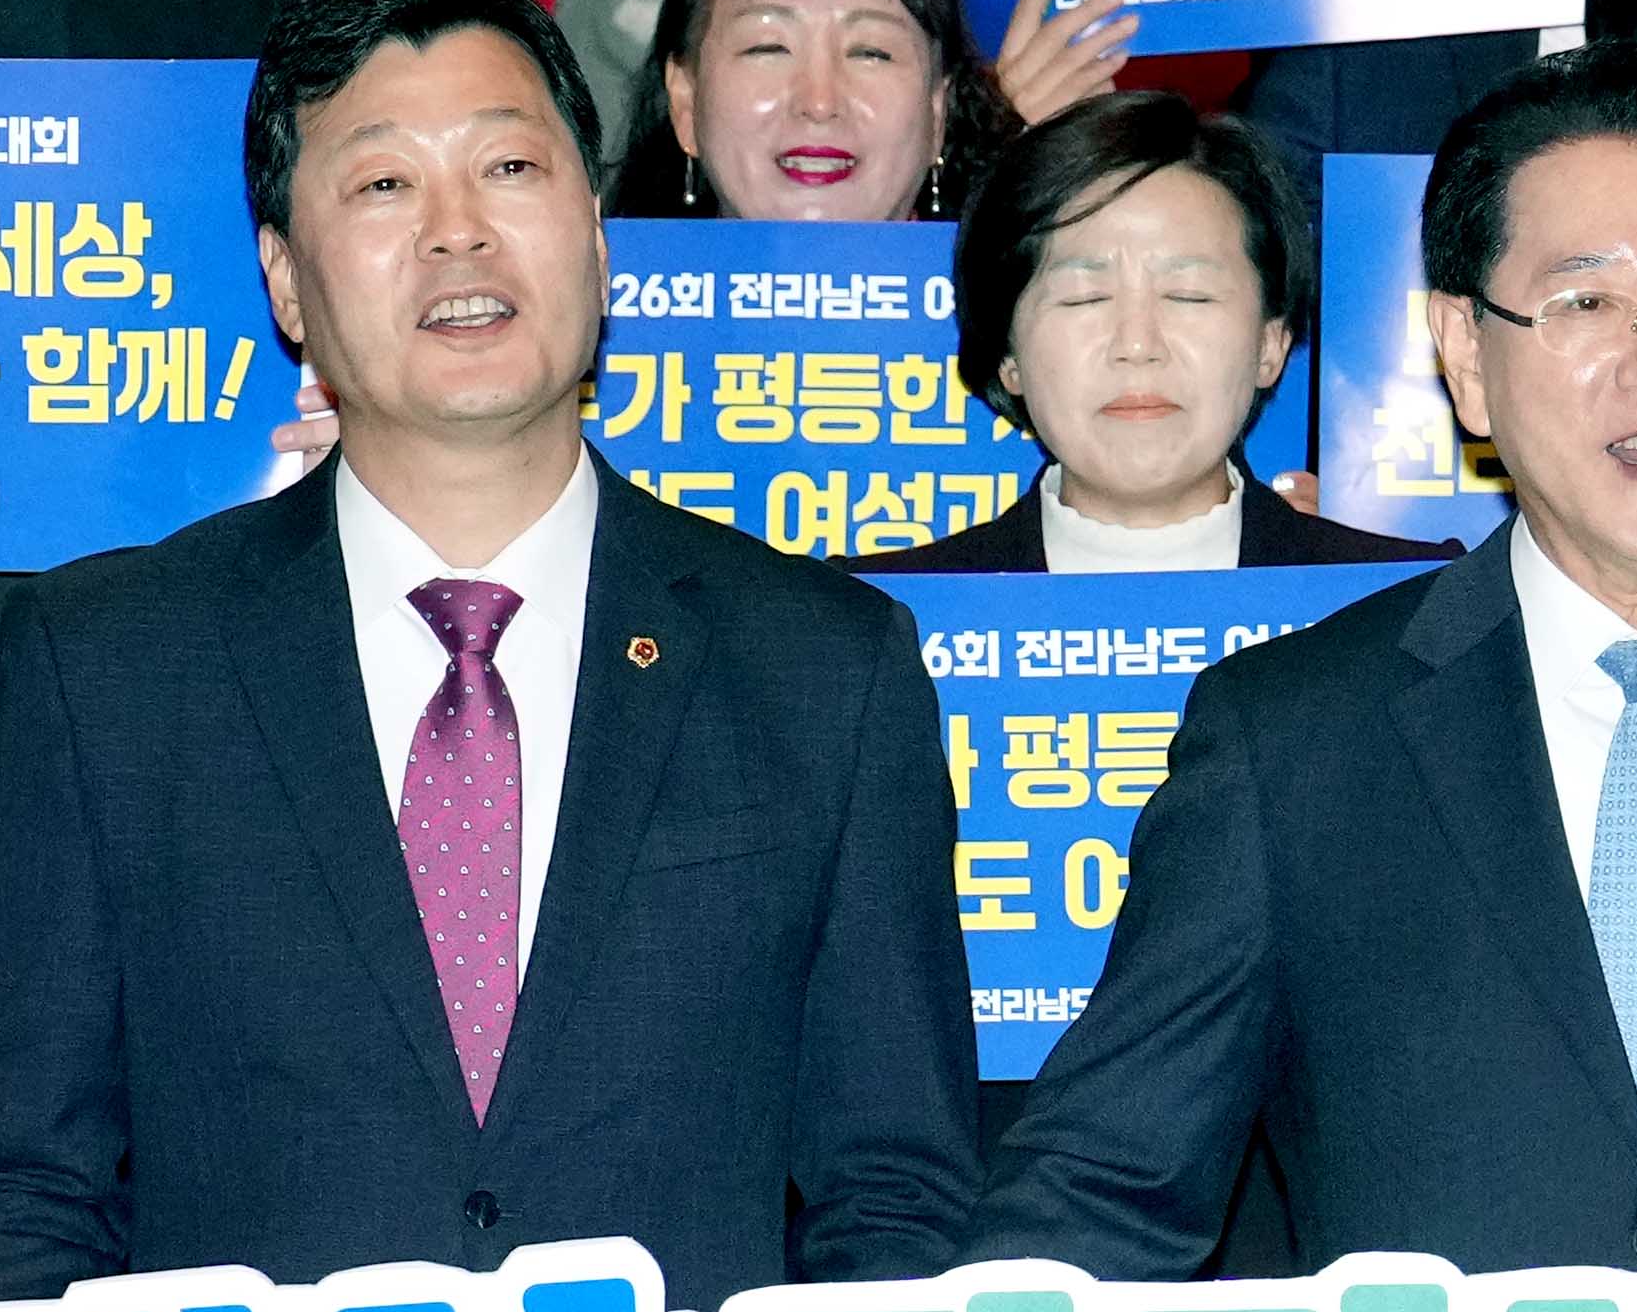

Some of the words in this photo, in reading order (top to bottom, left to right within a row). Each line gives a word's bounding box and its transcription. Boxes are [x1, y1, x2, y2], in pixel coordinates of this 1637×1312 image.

[728, 272, 910, 320] 전라남도
[21, 326, 256, 424] 함께!
[712, 351, 971, 445] 평등한
[1015, 627, 1209, 678] 전라남도
